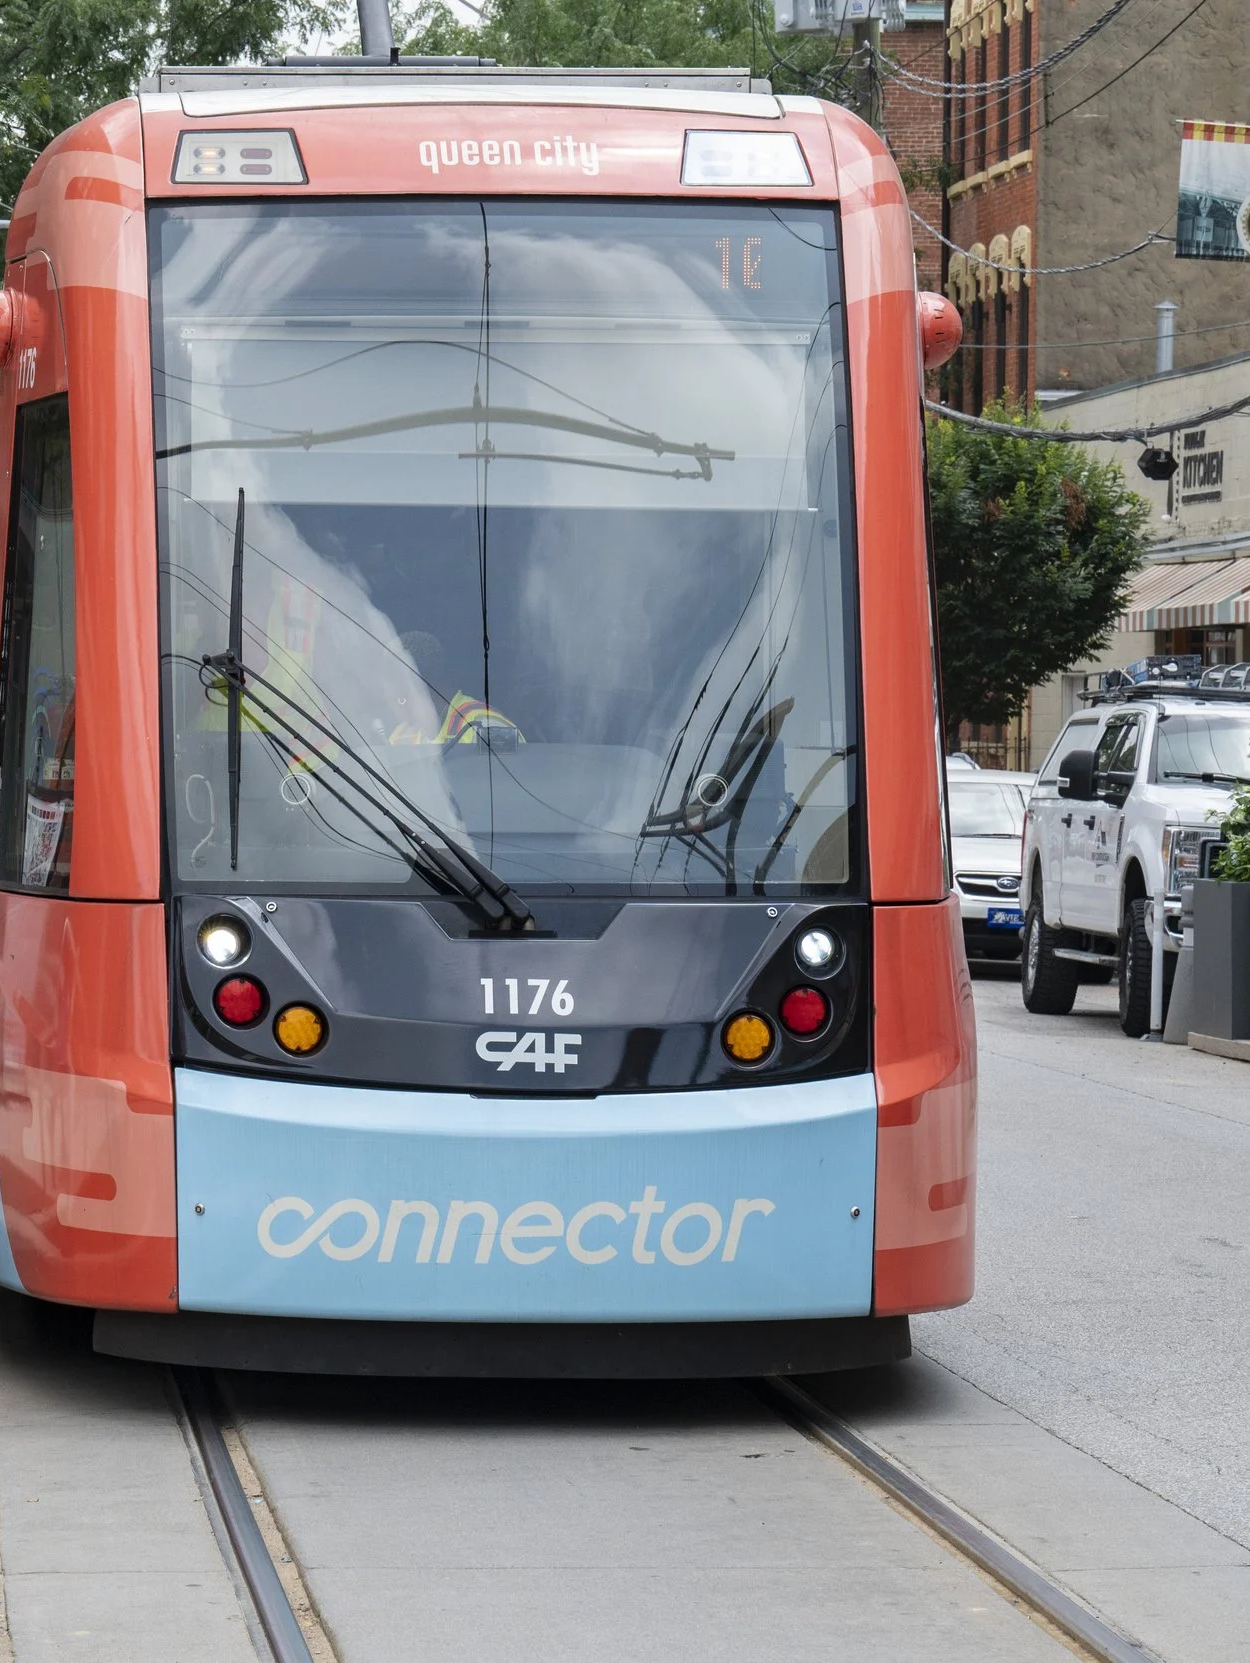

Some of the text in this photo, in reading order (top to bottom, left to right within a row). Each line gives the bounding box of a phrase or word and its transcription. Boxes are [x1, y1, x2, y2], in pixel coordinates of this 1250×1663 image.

[419, 135, 600, 176] queen city
[18, 347, 37, 390] 1176
[1182, 450, 1224, 489] KITCHEN
[480, 978, 574, 1016] 1176
[475, 1031, 582, 1073] CAF
[257, 1185, 776, 1266] connector
